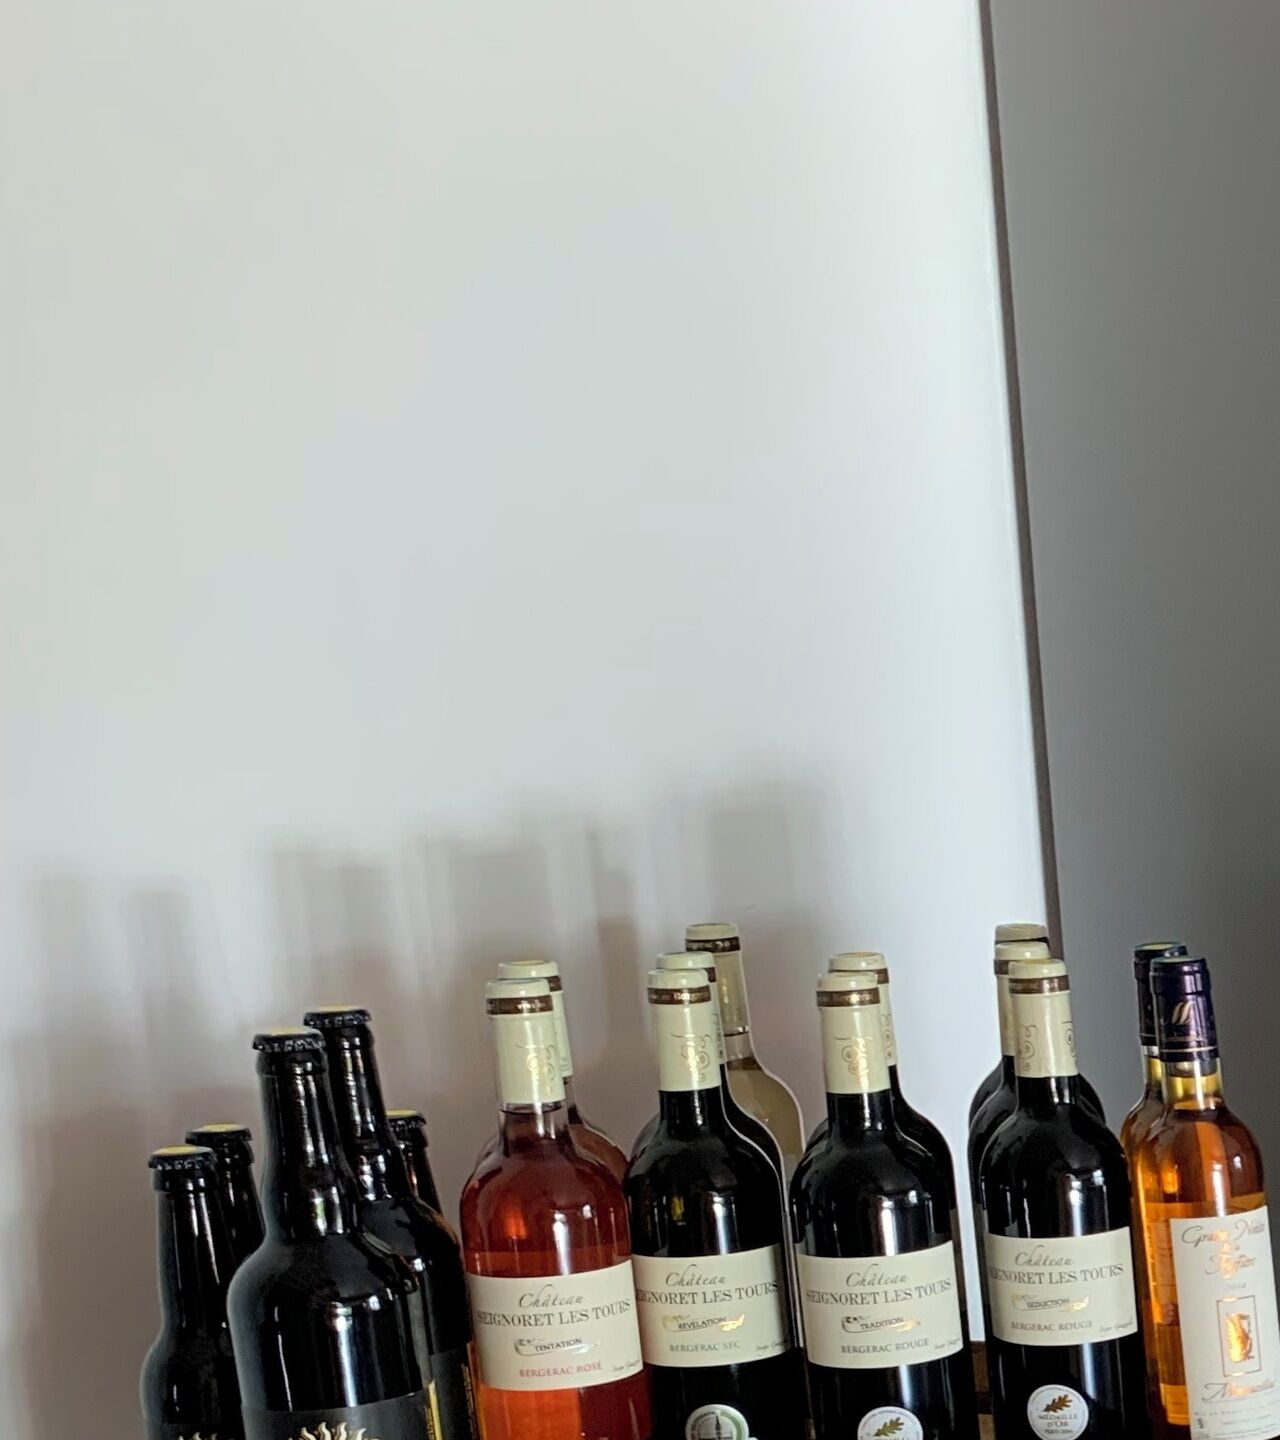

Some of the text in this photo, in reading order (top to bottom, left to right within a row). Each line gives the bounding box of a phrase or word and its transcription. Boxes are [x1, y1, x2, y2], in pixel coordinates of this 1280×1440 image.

[1014, 1244, 1074, 1268] Château
[665, 1263, 727, 1289] Château
[845, 1263, 909, 1288] Château
[1049, 1270, 1079, 1285] LES
[1080, 1262, 1125, 1282] TOURS
[518, 1283, 586, 1309] Château
[702, 1289, 733, 1304] LES
[734, 1280, 779, 1300] TOURS
[884, 1288, 913, 1303] LES
[914, 1277, 952, 1299] TOURS
[559, 1308, 590, 1325] LES
[591, 1297, 632, 1320] TOURS
[859, 1316, 905, 1330] TRADITION
[1011, 1321, 1056, 1331] BERGERAC
[1058, 1319, 1094, 1331] ROUGE
[534, 1337, 583, 1353] TENTATION
[669, 1343, 722, 1352] BERGERAC
[840, 1343, 894, 1355] BERGERAC
[894, 1337, 930, 1351] ROUGE
[519, 1365, 574, 1378] BERGERAC
